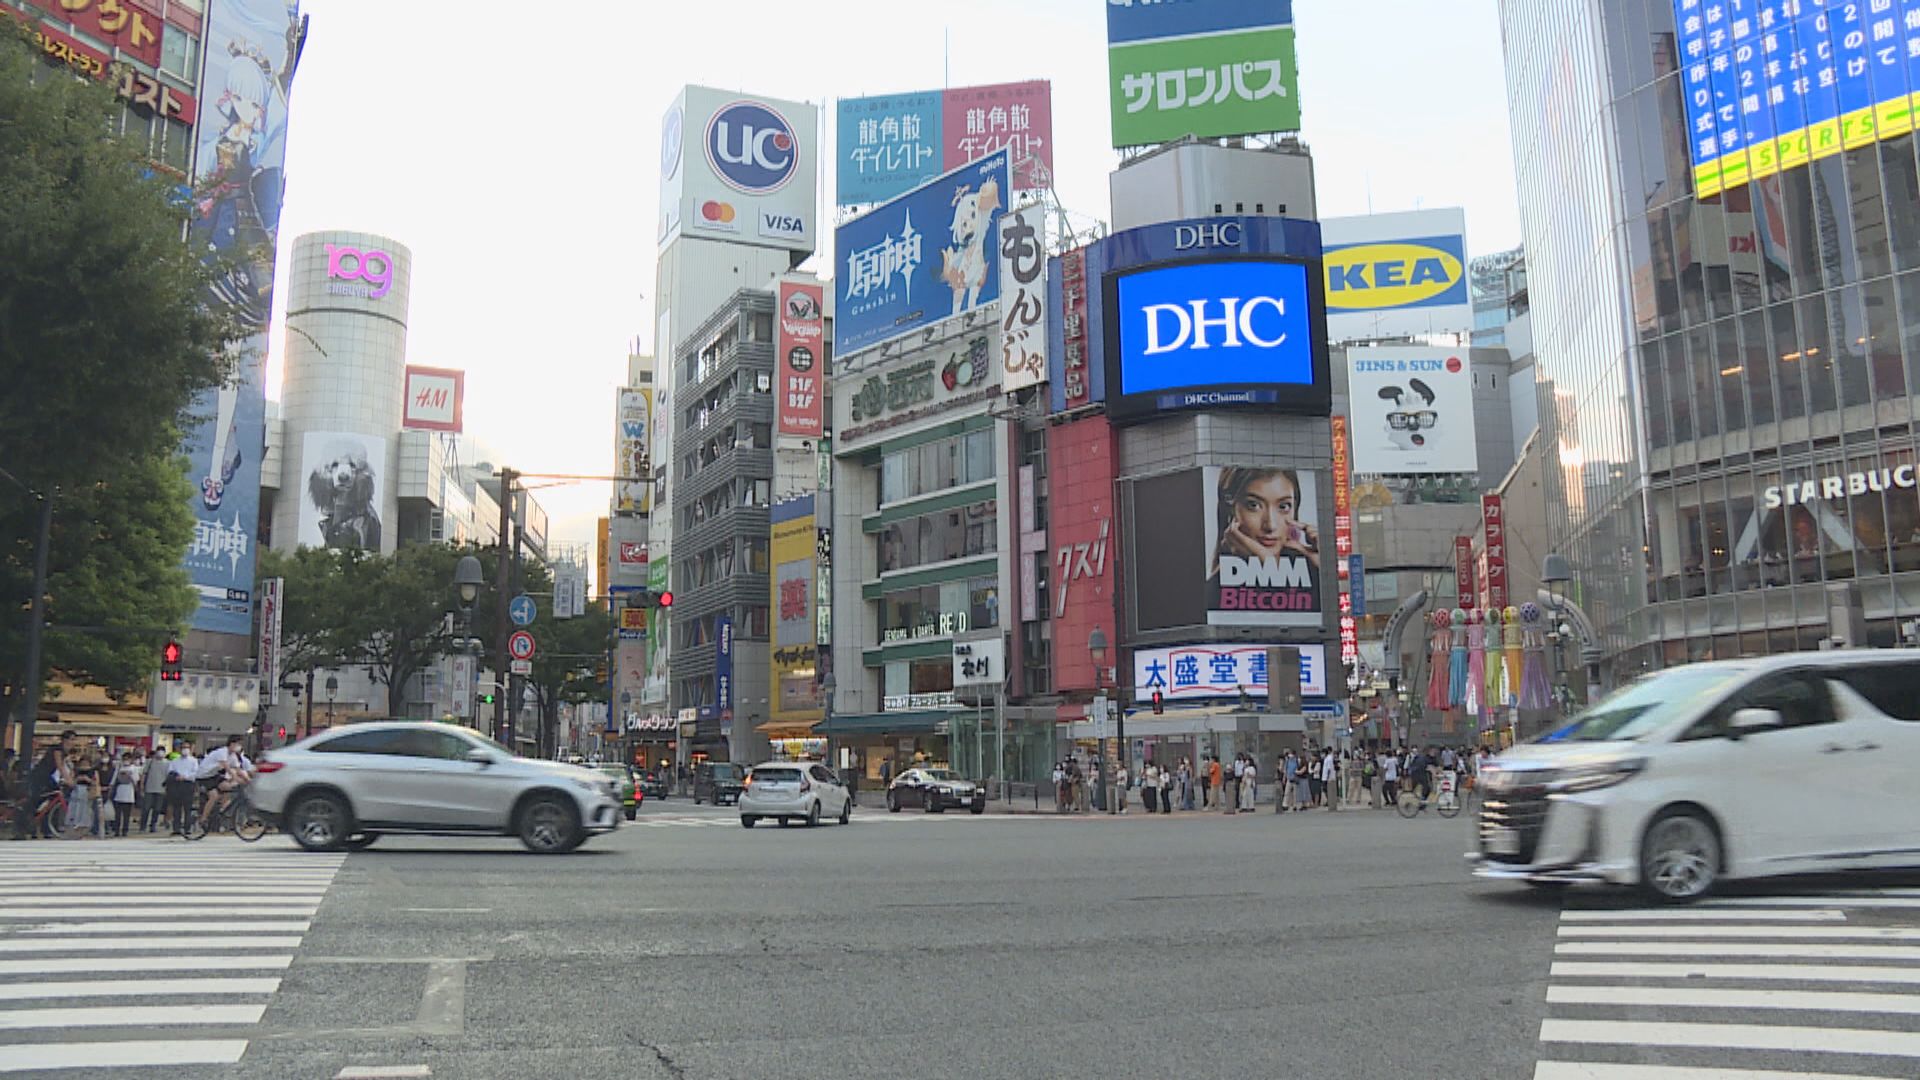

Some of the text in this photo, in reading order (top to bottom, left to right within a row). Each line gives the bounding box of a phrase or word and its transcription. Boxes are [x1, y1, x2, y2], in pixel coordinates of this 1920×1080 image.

[1687, 0, 1826, 57] 甲子園球場
[1121, 59, 1287, 113] サロンパス
[858, 114, 920, 145] 龍角散
[967, 104, 1030, 135] 龍角散
[1699, 128, 1754, 157] 選手。
[1760, 114, 1873, 166] SPORTS
[851, 142, 933, 174] ダイレクト
[765, 215, 803, 232] VISA
[1175, 222, 1241, 249] DHC
[324, 243, 393, 299] 109
[845, 207, 922, 306] 原神
[1328, 258, 1450, 292] KEA
[851, 292, 897, 316] Genshin
[1003, 214, 1043, 379] もんじゃ
[1141, 296, 1287, 355] DHC
[1356, 359, 1443, 372] JINS & SUN
[789, 376, 813, 391] B1F
[1185, 392, 1250, 405] DHC Channel
[789, 393, 814, 409] B2F
[1764, 464, 1920, 508] STARBUC
[1485, 505, 1504, 577] カラオケ
[1056, 516, 1110, 618] クスリ
[1220, 555, 1312, 587] DMM
[1220, 588, 1312, 609] Bitcoin
